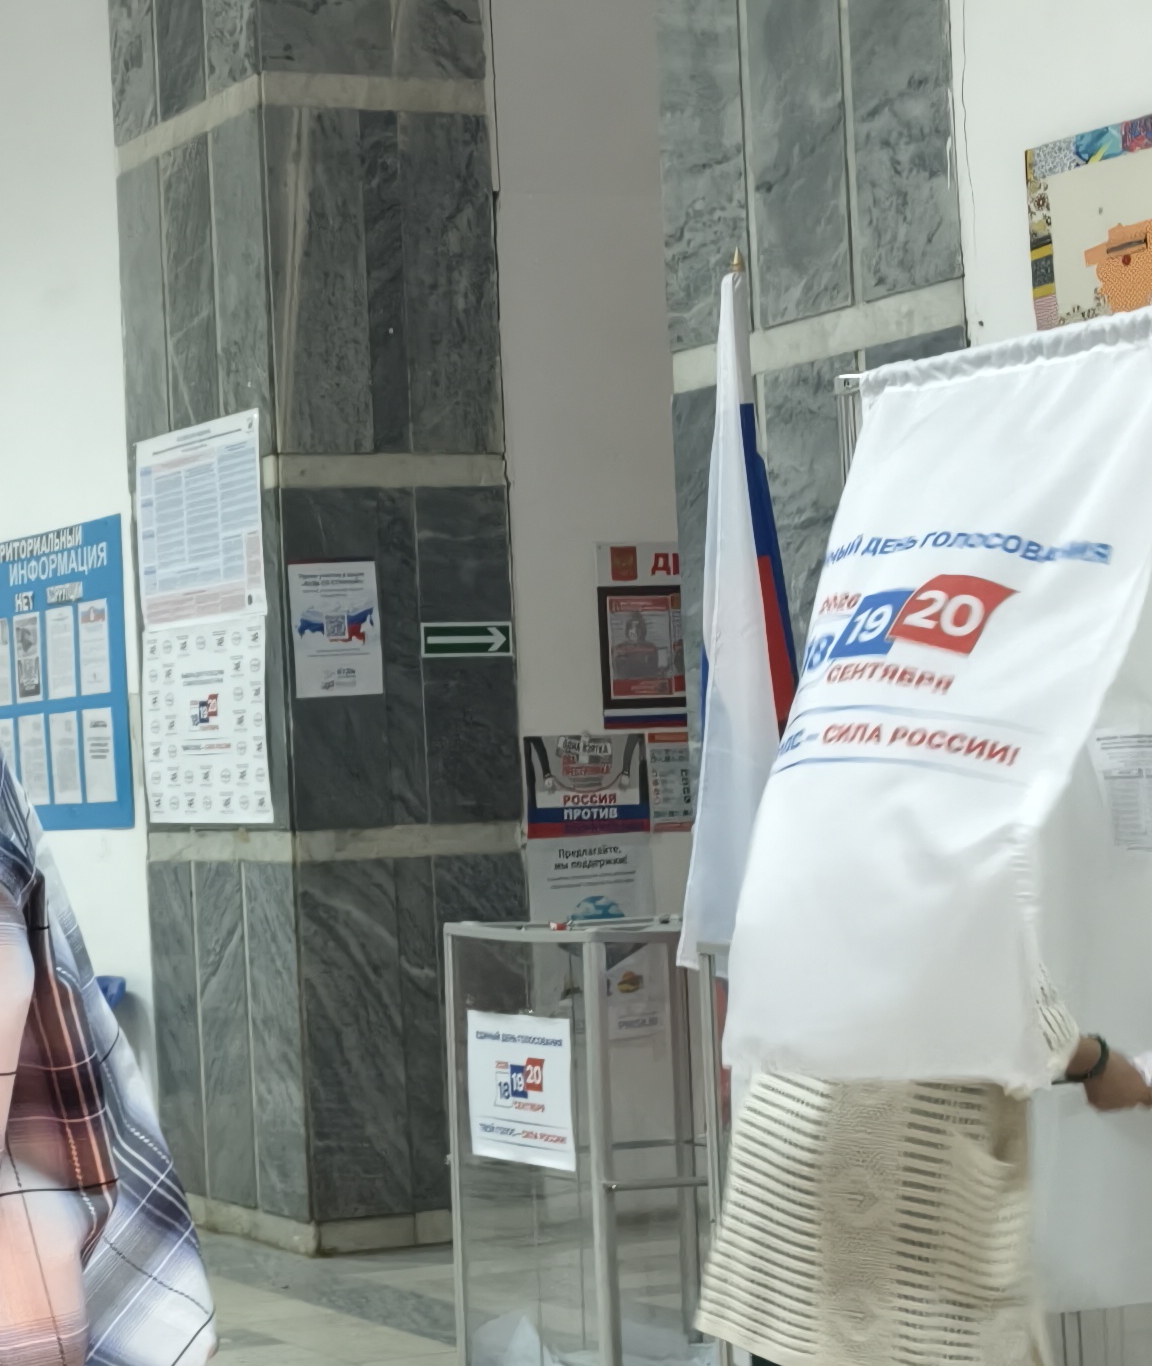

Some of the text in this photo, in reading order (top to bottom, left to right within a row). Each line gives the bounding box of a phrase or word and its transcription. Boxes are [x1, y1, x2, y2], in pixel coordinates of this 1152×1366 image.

[861, 535, 917, 557] ДЕНЬ
[9, 542, 107, 587] ИНФОРМАЦИЯ
[15, 591, 33, 612] НЕТ
[845, 604, 894, 646] 19
[902, 589, 986, 638] 20
[825, 661, 956, 695] СЕНТЯБРЯ
[821, 722, 882, 745] СИЛА
[887, 726, 1021, 767] РОССИИ!
[562, 792, 617, 806] РОССИЯ
[563, 807, 618, 821] ПРОТИВ
[526, 1065, 542, 1085] 20
